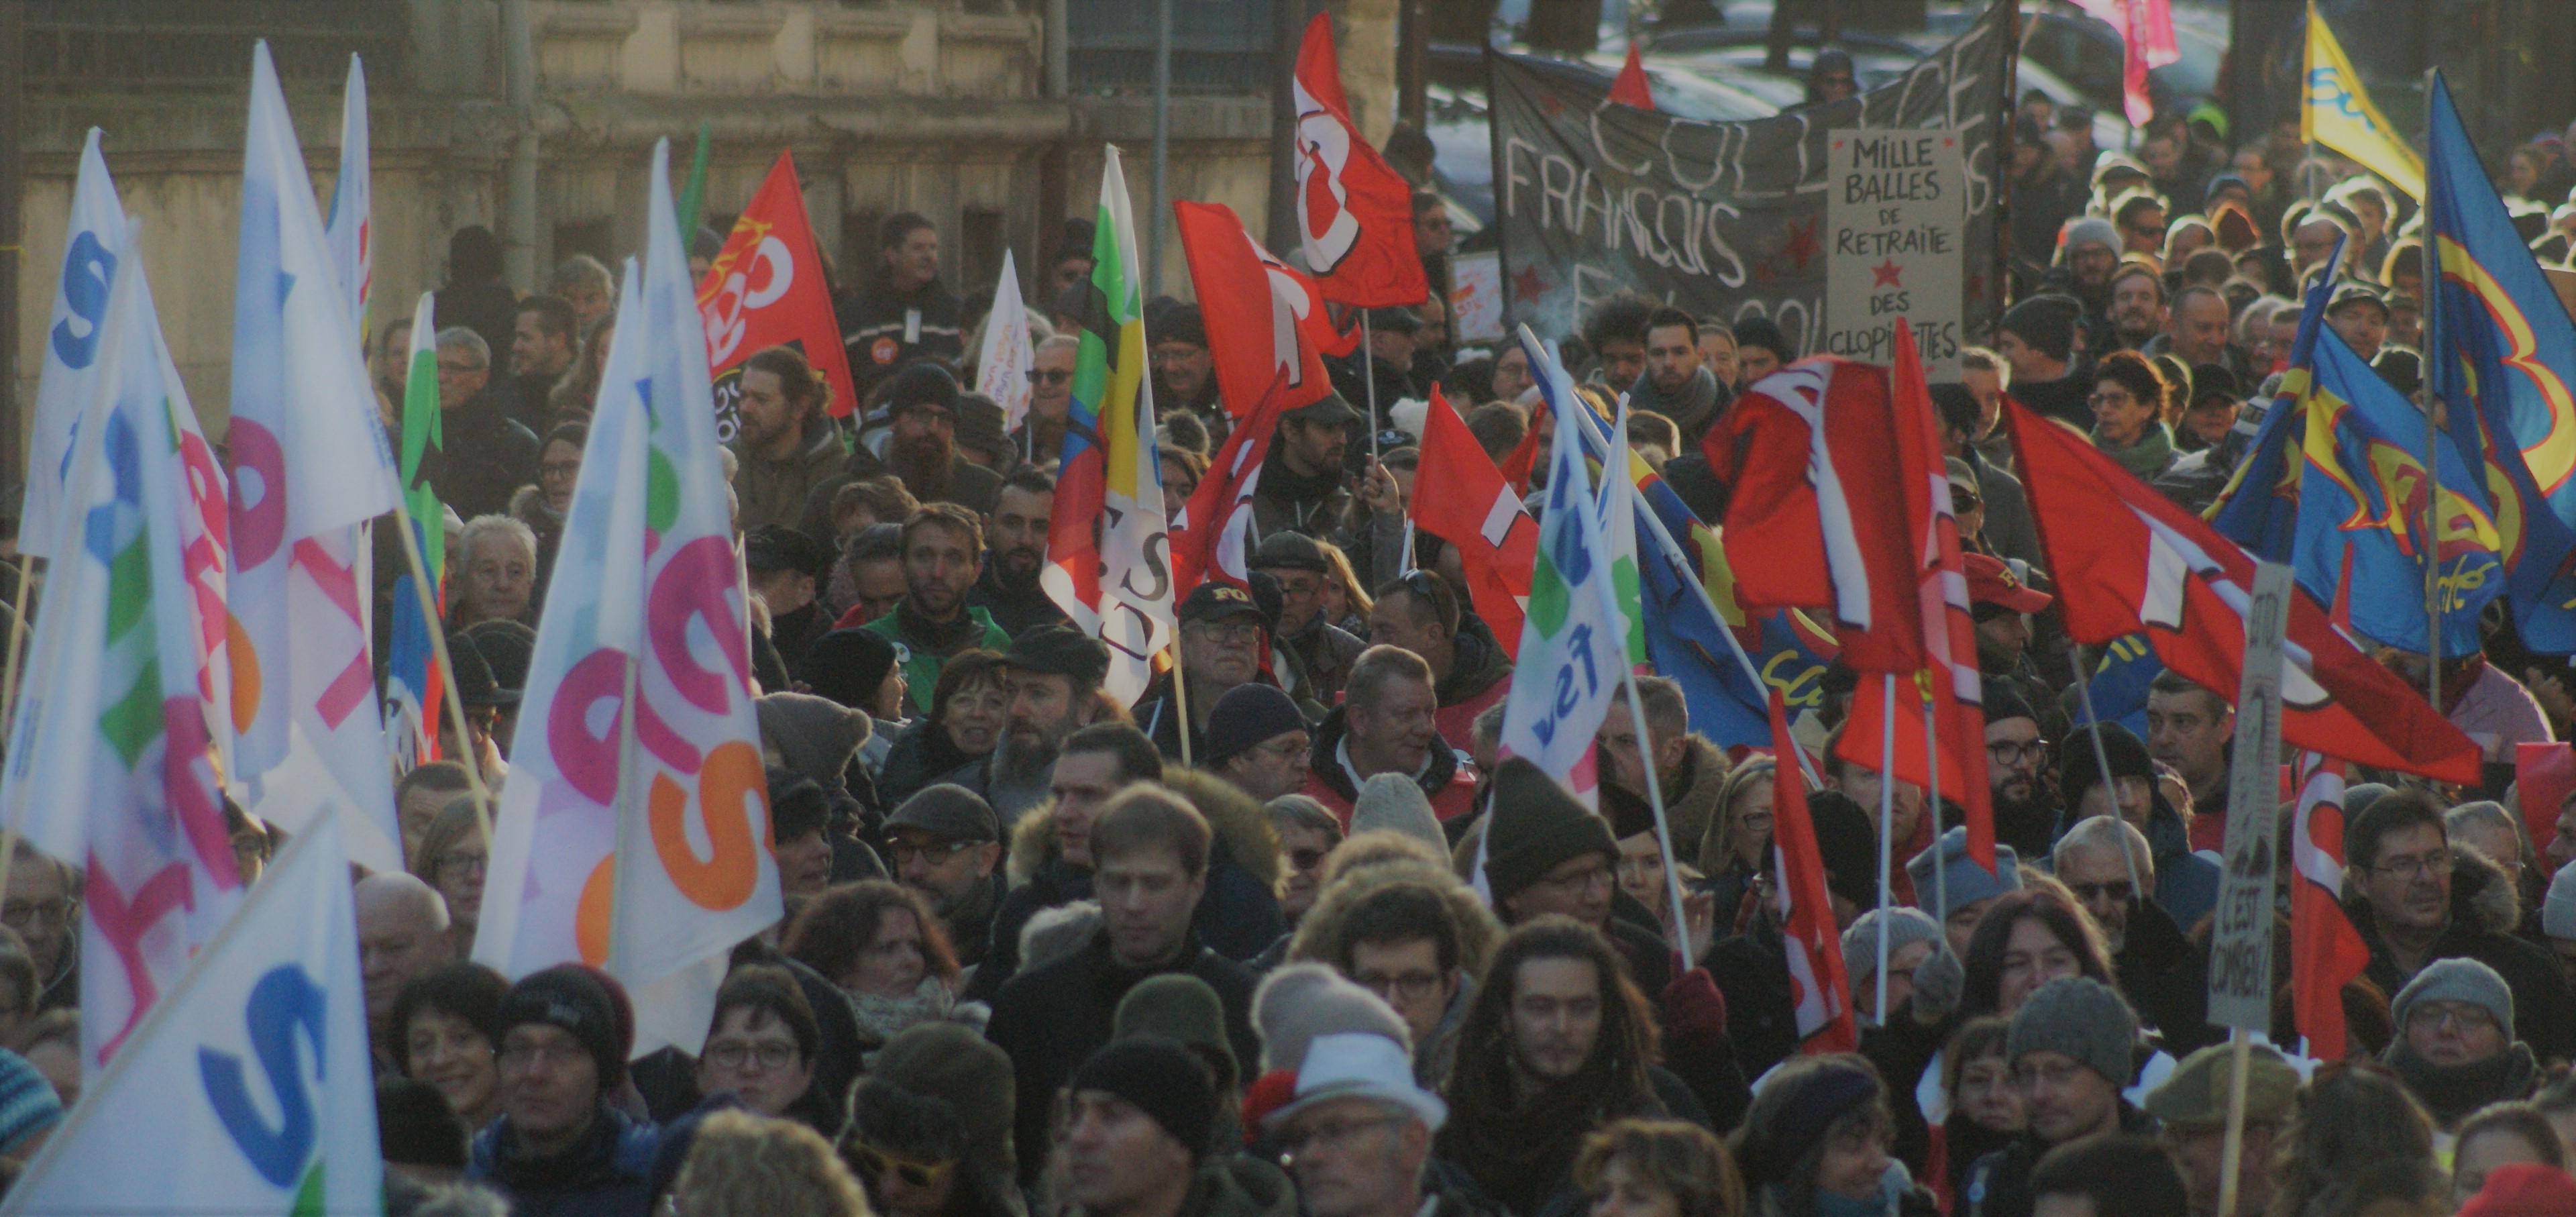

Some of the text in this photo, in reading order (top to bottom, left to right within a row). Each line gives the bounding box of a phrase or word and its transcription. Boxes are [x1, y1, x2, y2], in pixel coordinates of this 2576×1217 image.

[1845, 170, 1941, 204] BALLES
[1879, 208, 1900, 225] DE
[1870, 291, 1910, 316] DES
